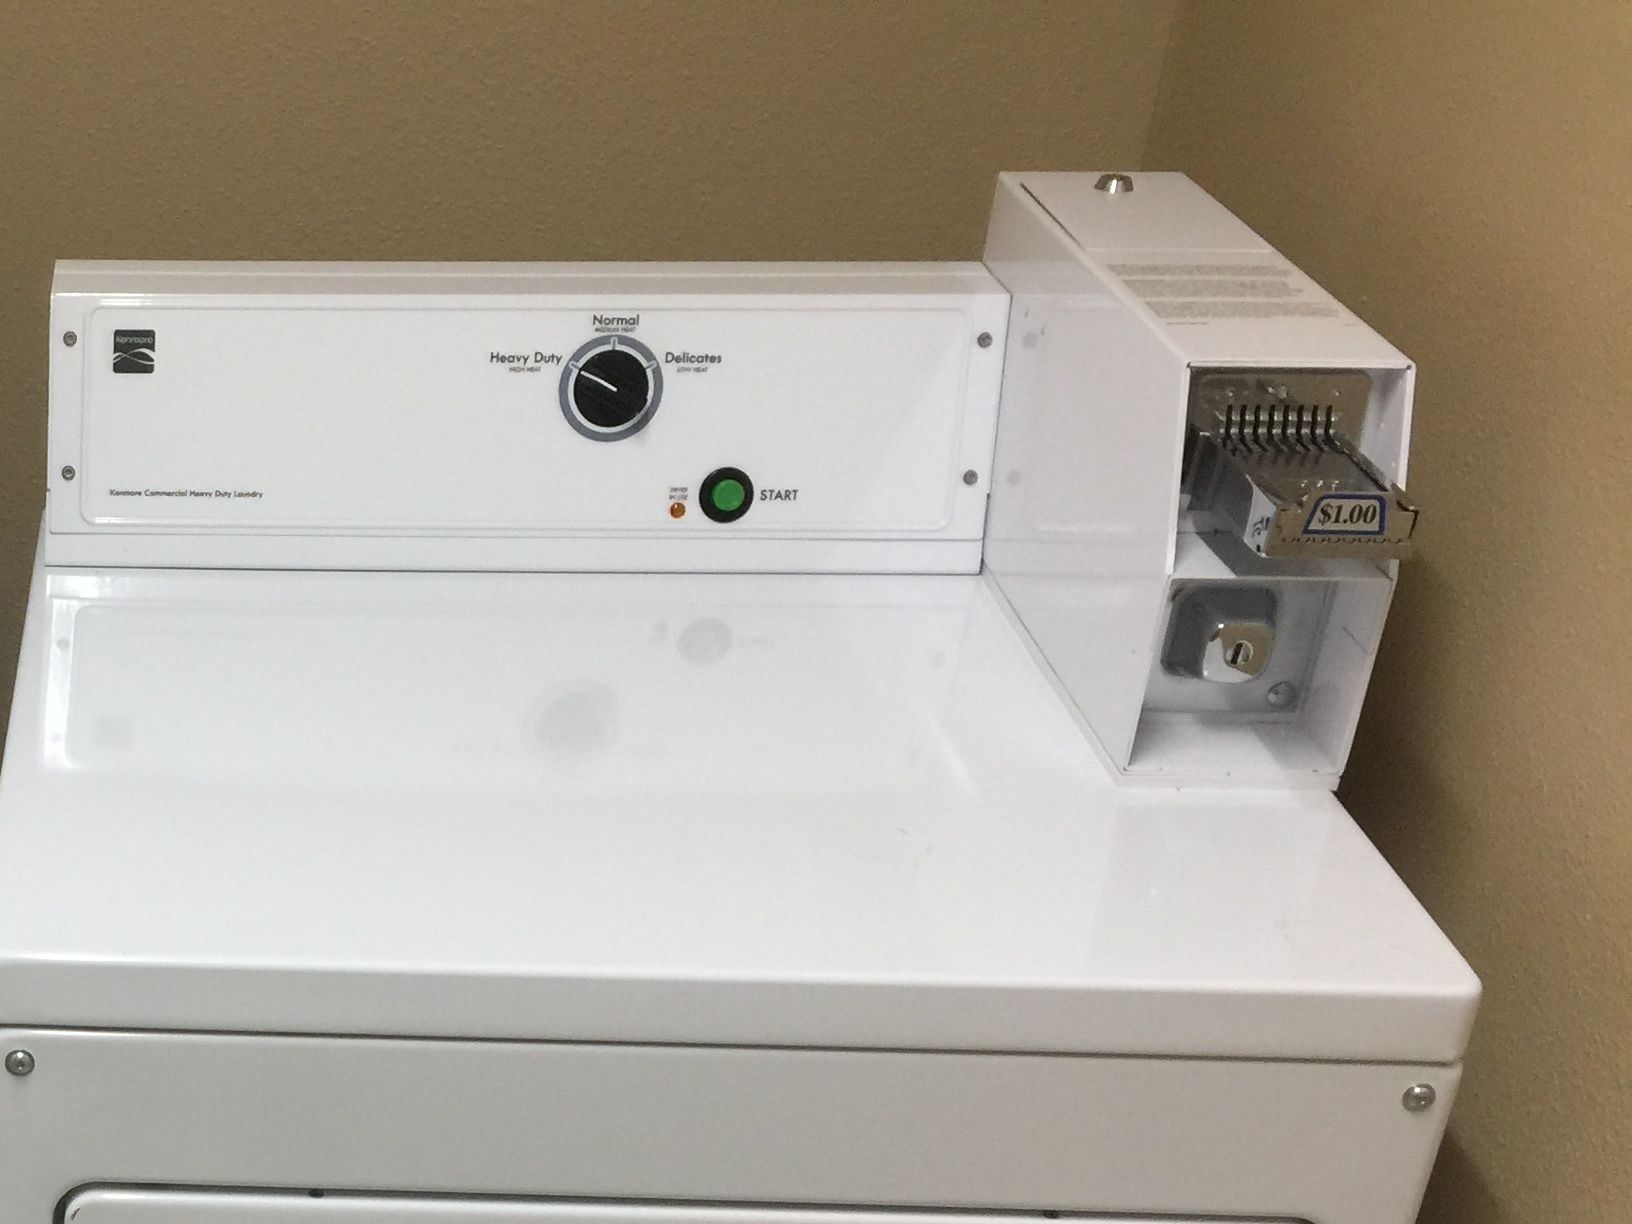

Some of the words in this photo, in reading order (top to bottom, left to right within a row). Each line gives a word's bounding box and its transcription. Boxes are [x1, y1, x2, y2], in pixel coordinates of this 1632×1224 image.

[593, 314, 639, 326] Normal
[490, 352, 529, 365] Heavy
[534, 352, 562, 365] Duty
[665, 352, 722, 364] Delicates
[144, 489, 187, 497] Commercial
[189, 490, 212, 498] Heavy
[214, 490, 231, 498] Duty
[234, 491, 263, 499] Laundry
[759, 489, 798, 501] START
[1319, 503, 1377, 526] $1.00
